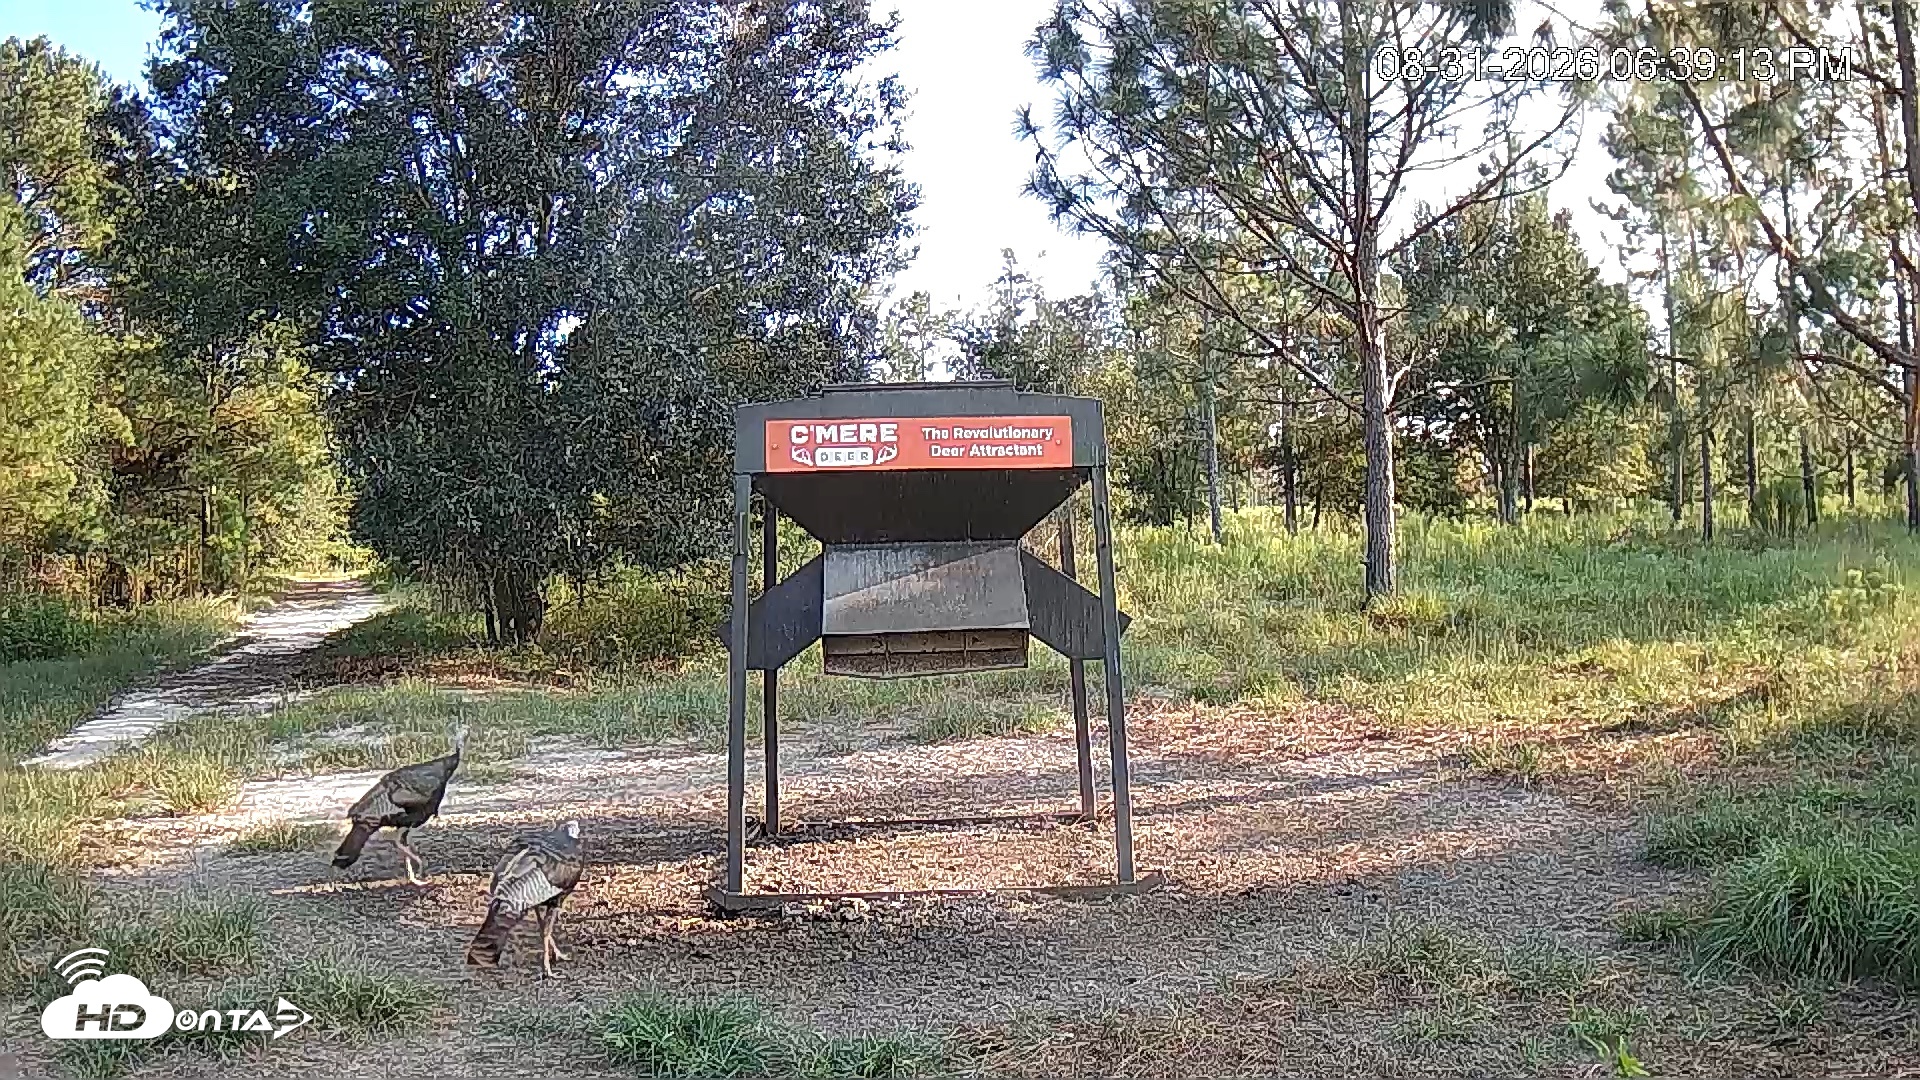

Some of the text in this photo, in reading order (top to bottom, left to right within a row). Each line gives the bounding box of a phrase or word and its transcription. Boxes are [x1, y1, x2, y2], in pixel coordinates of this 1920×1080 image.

[791, 424, 898, 444] C'MERE
[921, 425, 1053, 441] The Revolutionary
[819, 452, 869, 462] DEER
[931, 444, 1043, 457] Deer Attractant
